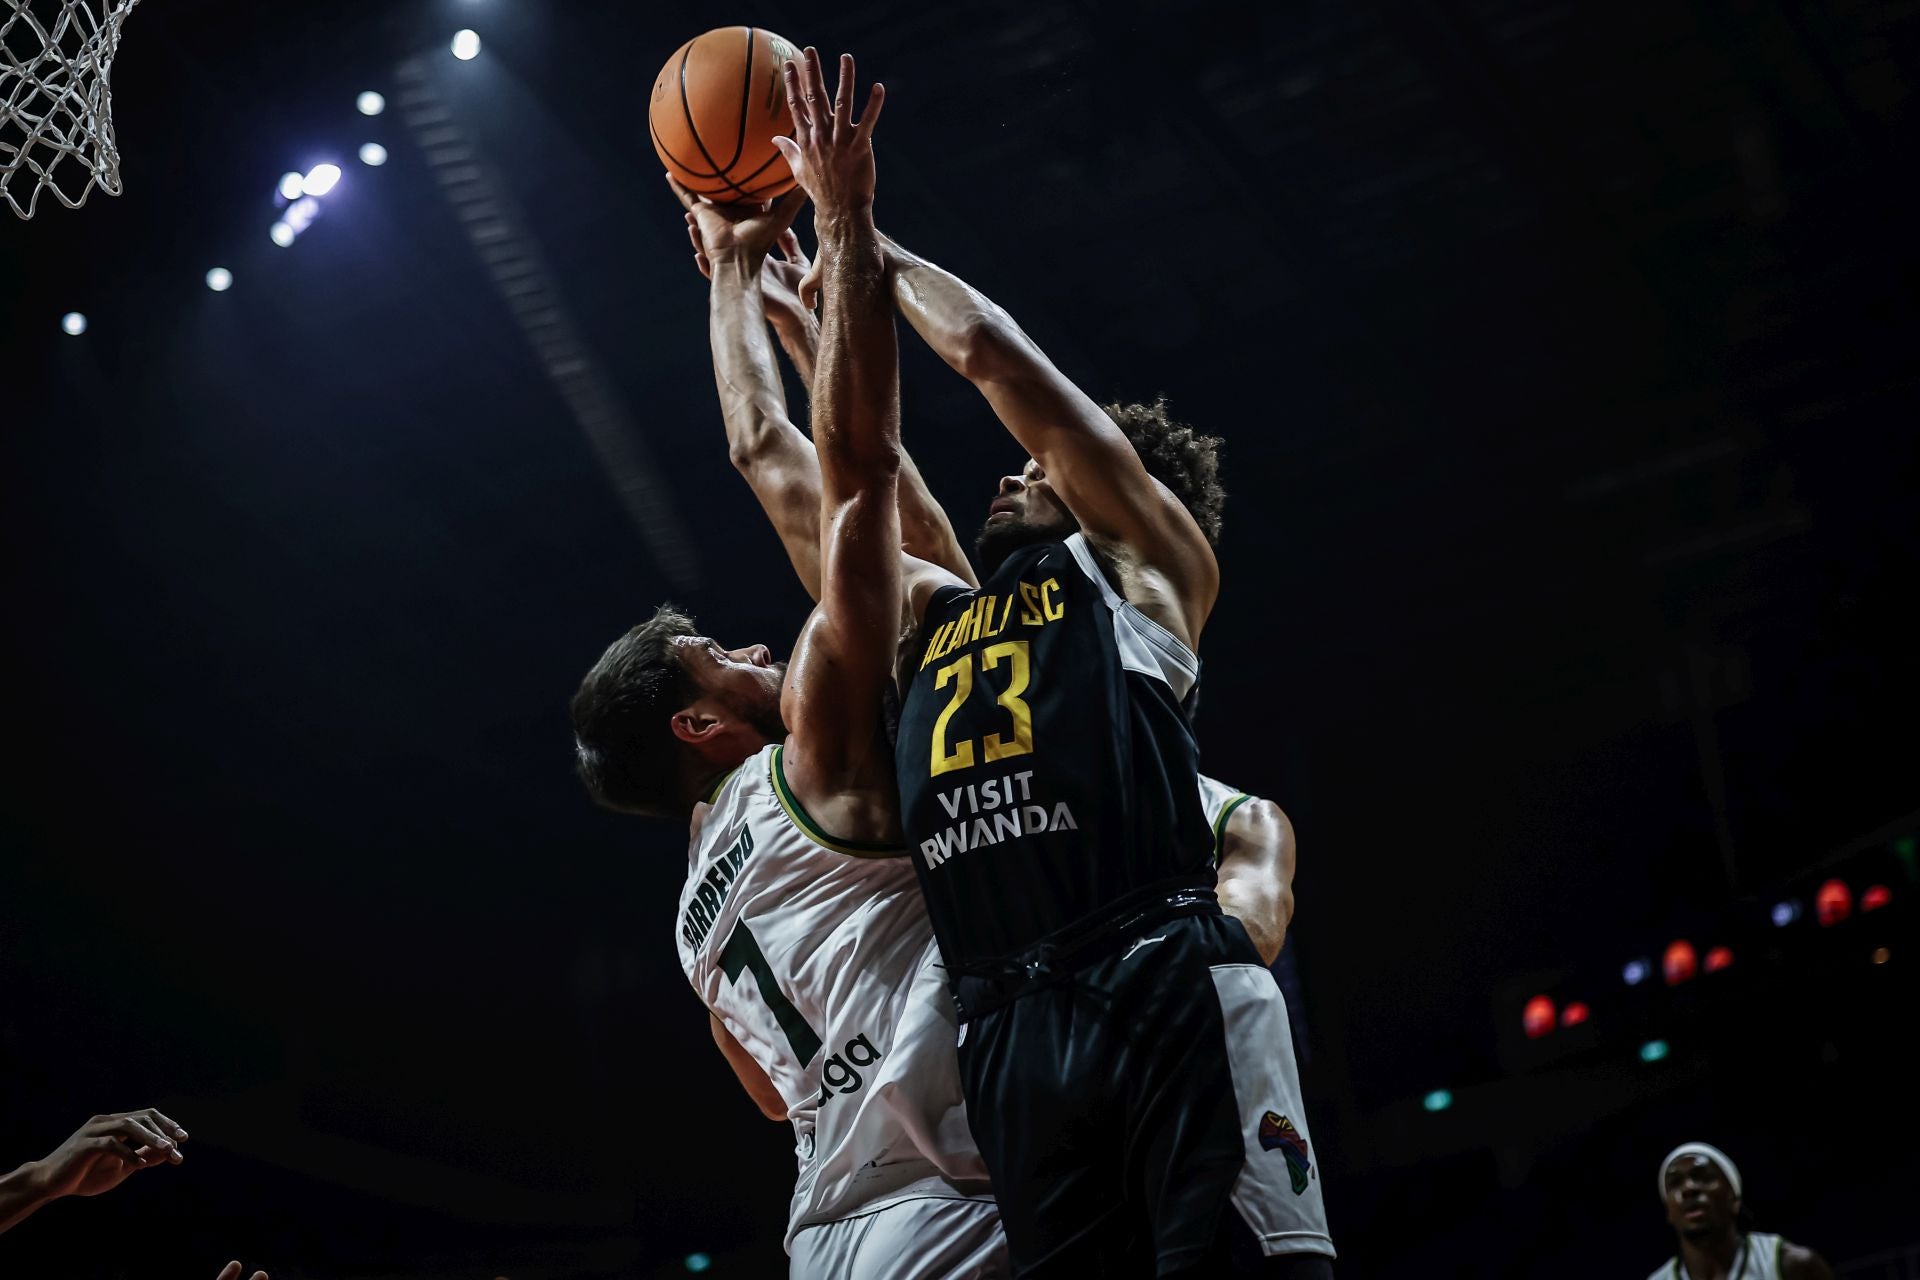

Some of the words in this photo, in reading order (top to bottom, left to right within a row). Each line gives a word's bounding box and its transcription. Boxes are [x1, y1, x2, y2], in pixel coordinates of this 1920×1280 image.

[1019, 577, 1065, 626] SC
[930, 640, 1035, 778] 23
[937, 770, 1034, 820] VISIT
[919, 801, 1079, 871] RWANDA
